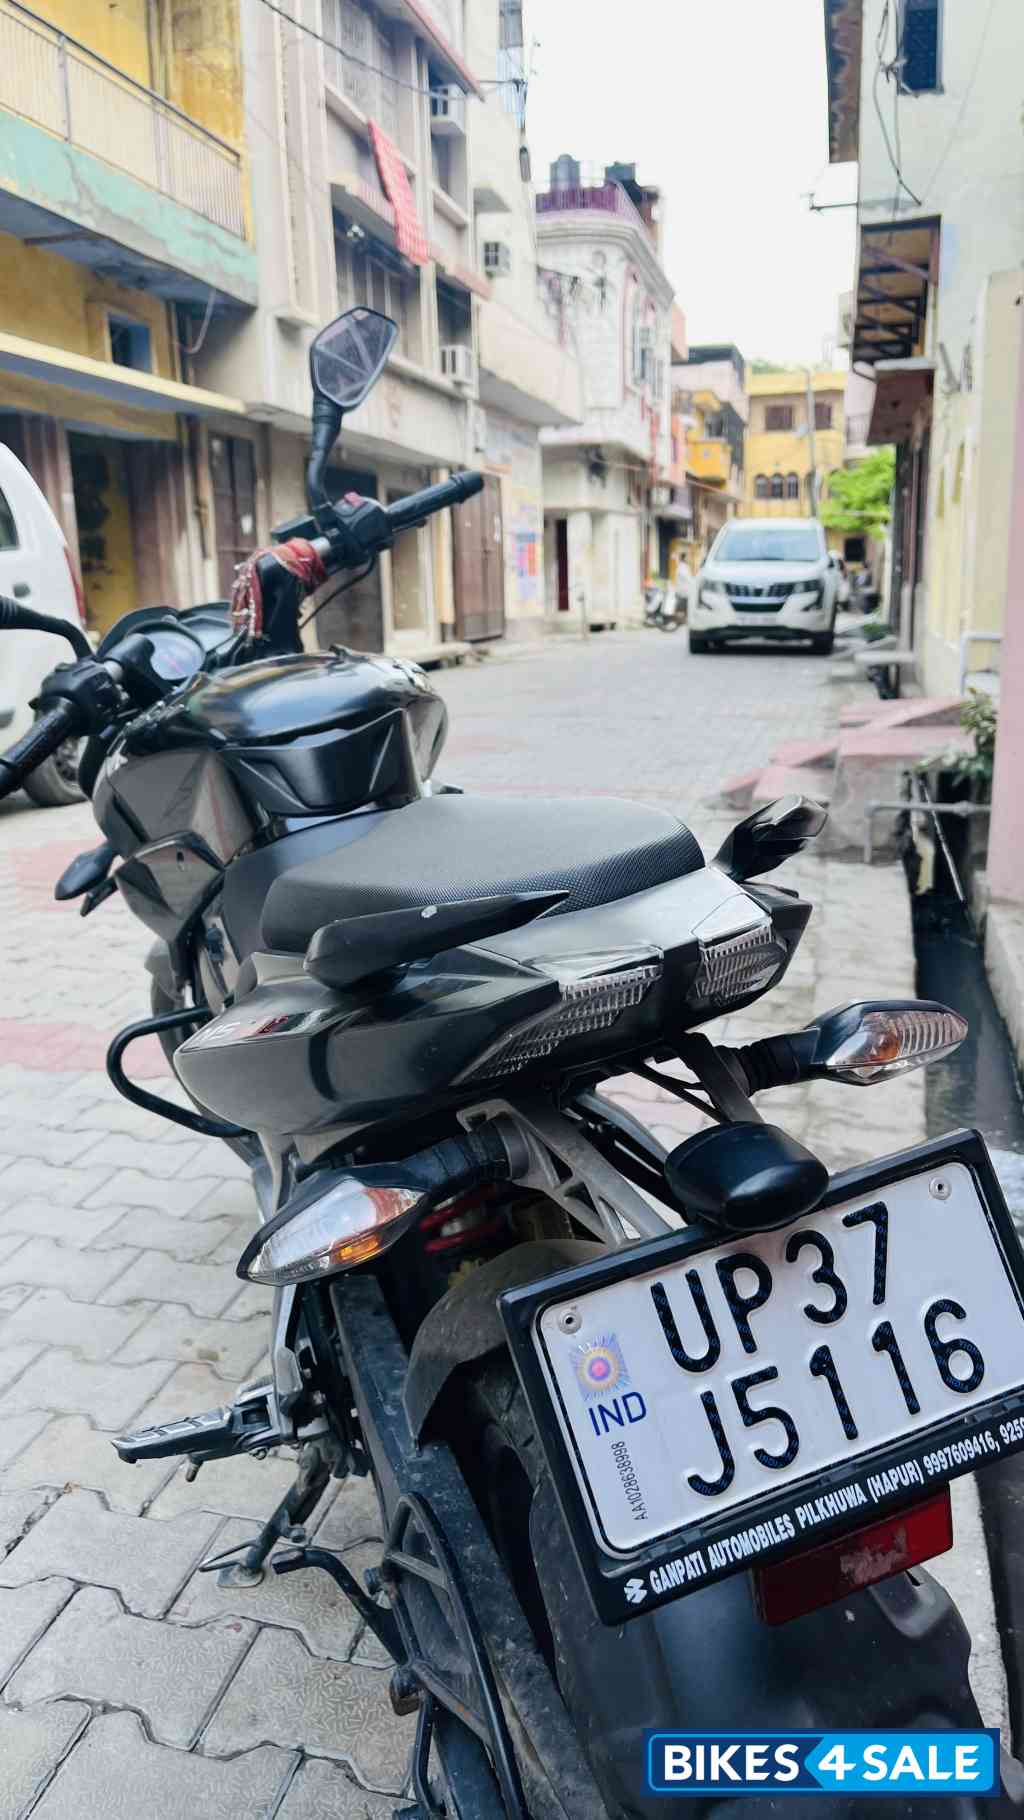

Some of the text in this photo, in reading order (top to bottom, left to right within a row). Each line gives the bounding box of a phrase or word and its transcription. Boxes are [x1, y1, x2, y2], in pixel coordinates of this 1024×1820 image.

[588, 1391, 647, 1438] IND
[649, 1550, 707, 1594] GANPATI
[707, 1513, 796, 1570] AUTOMOBILES
[795, 1483, 868, 1528] PILKHUWA
[867, 1459, 925, 1501] (HAPUR)
[923, 1430, 1000, 1476] 9997609416,
